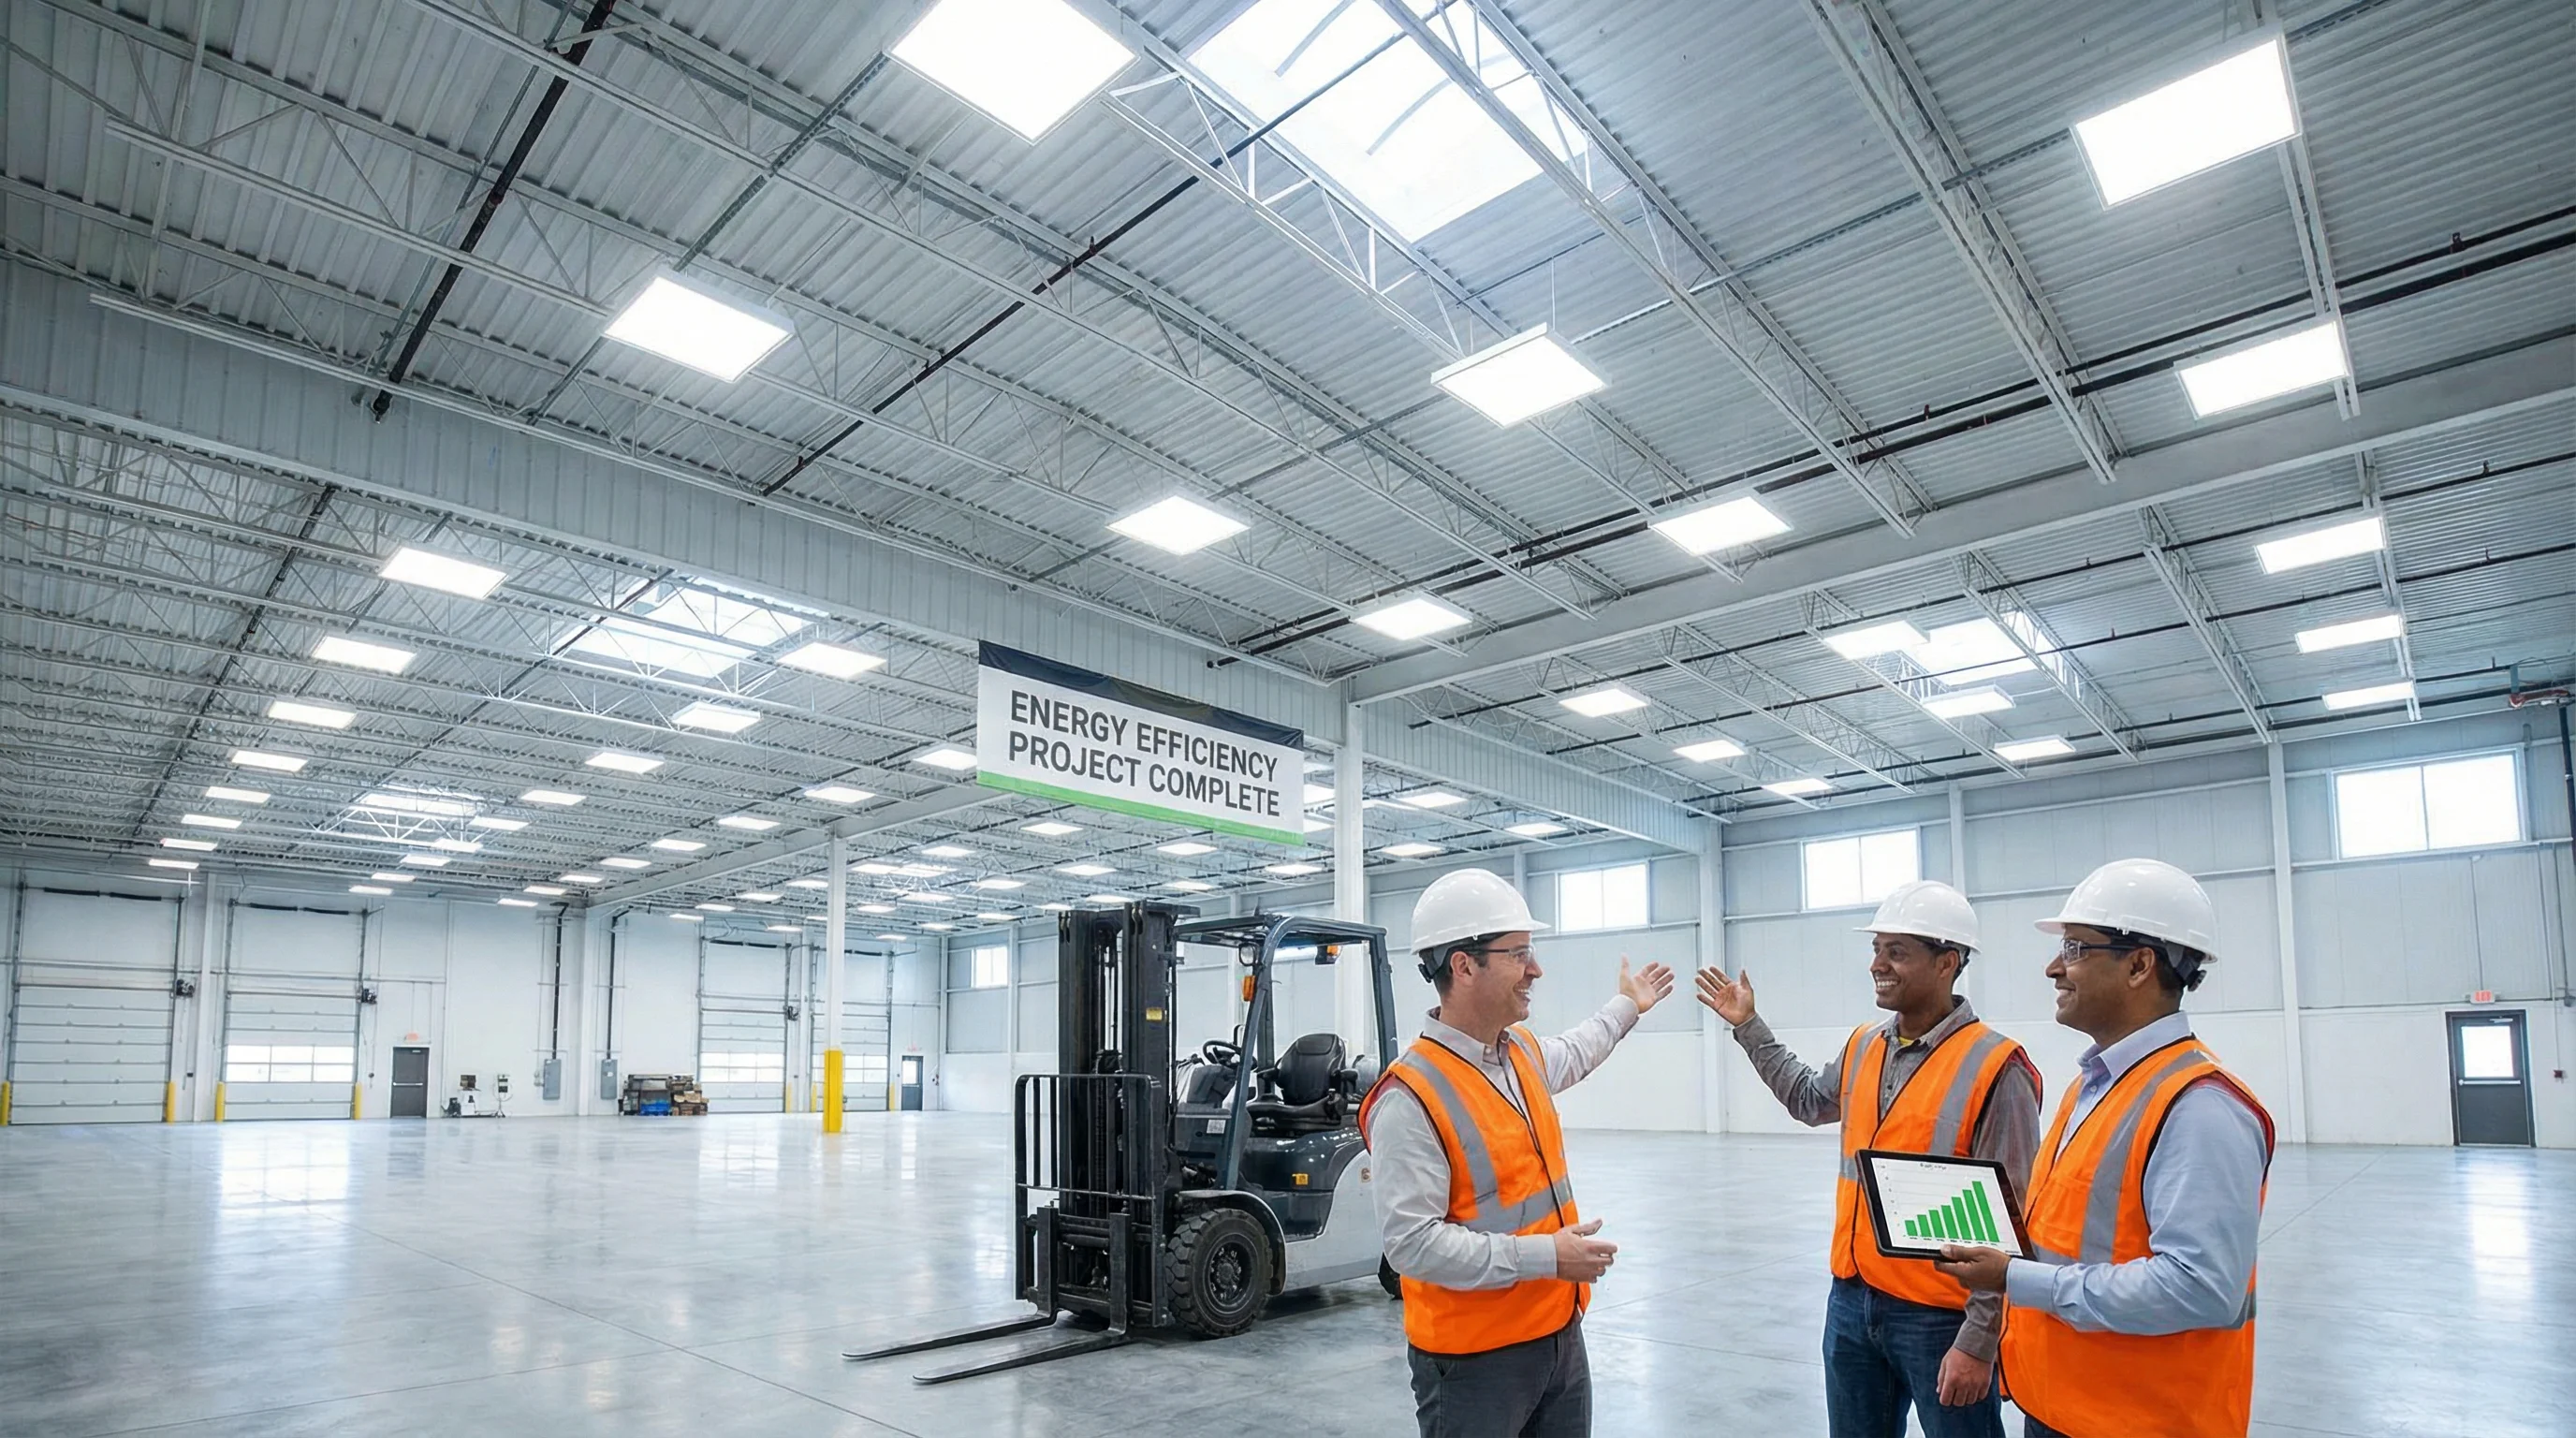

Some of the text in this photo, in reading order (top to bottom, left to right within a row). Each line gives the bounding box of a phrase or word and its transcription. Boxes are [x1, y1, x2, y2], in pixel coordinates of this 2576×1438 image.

[1009, 730, 1281, 817] PROJECT COMPLETE
[1011, 689, 1278, 783] ENERGY EFFICIENCY
